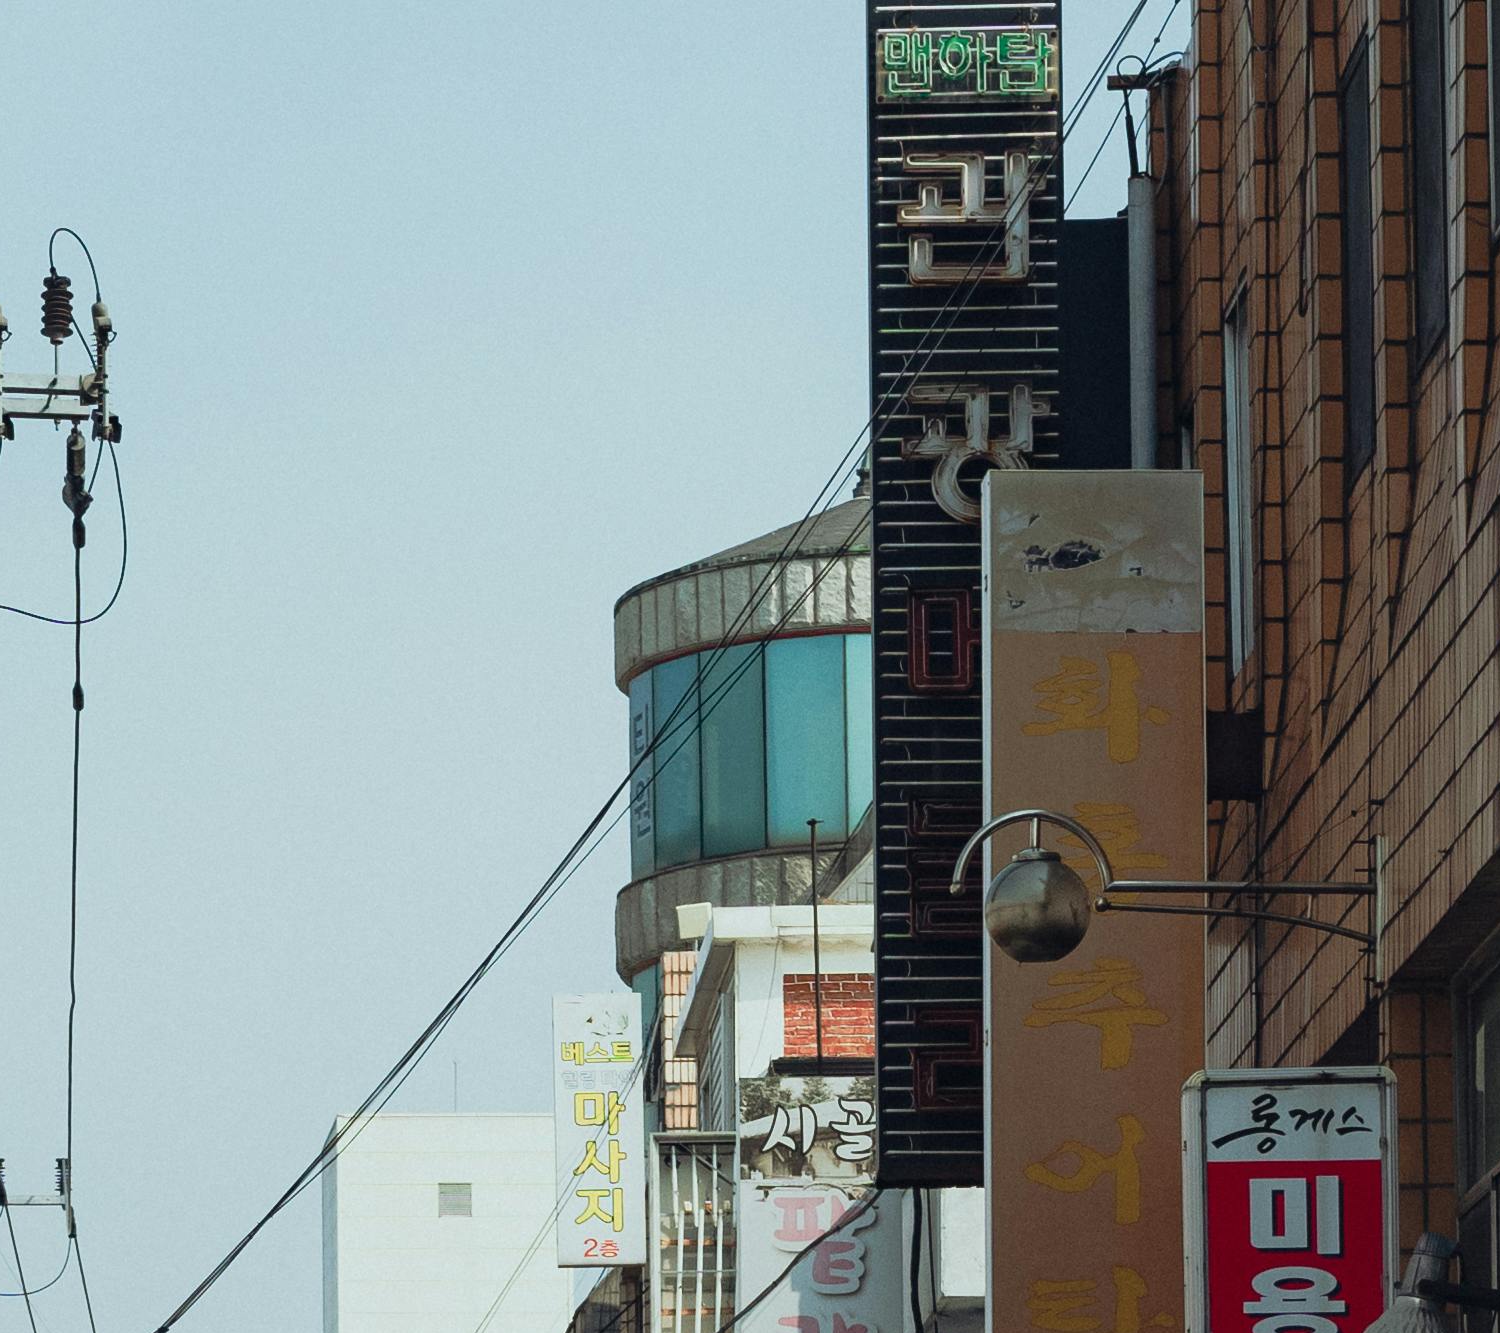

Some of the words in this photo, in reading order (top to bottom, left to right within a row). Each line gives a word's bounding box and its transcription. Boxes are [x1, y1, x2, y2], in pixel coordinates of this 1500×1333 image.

[883, 30, 1051, 94] 맨하탄
[561, 1041, 634, 1064] 베스트
[761, 1096, 877, 1162] 시골
[574, 1090, 626, 1233] 마사지
[583, 1237, 621, 1259] 2층
